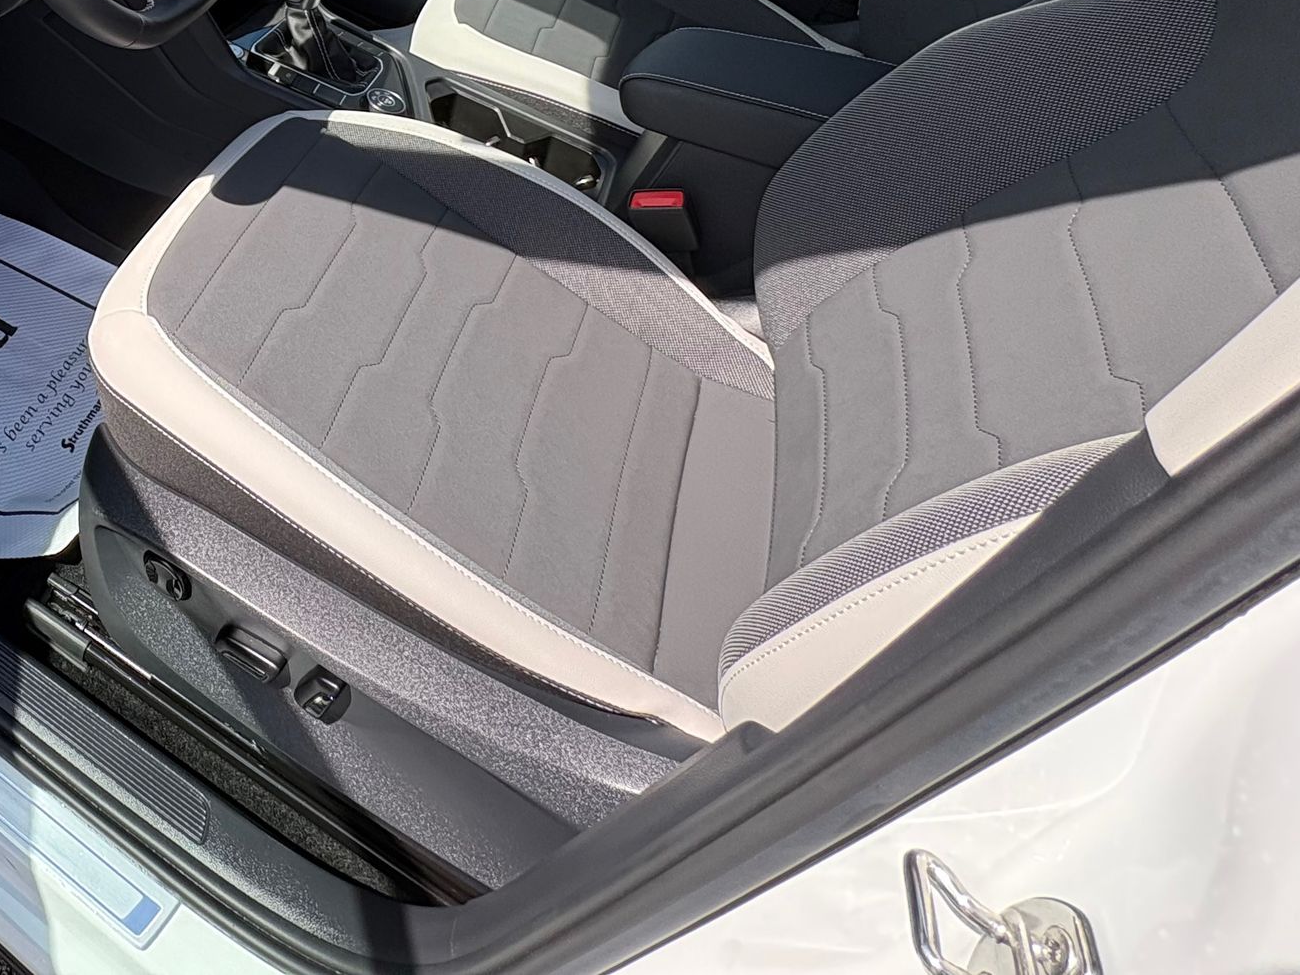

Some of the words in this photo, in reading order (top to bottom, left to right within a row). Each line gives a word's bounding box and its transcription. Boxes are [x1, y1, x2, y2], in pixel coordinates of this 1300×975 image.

[3, 405, 38, 442] been
[37, 393, 50, 405] a
[46, 339, 88, 396] pleasur
[25, 392, 76, 452] serving
